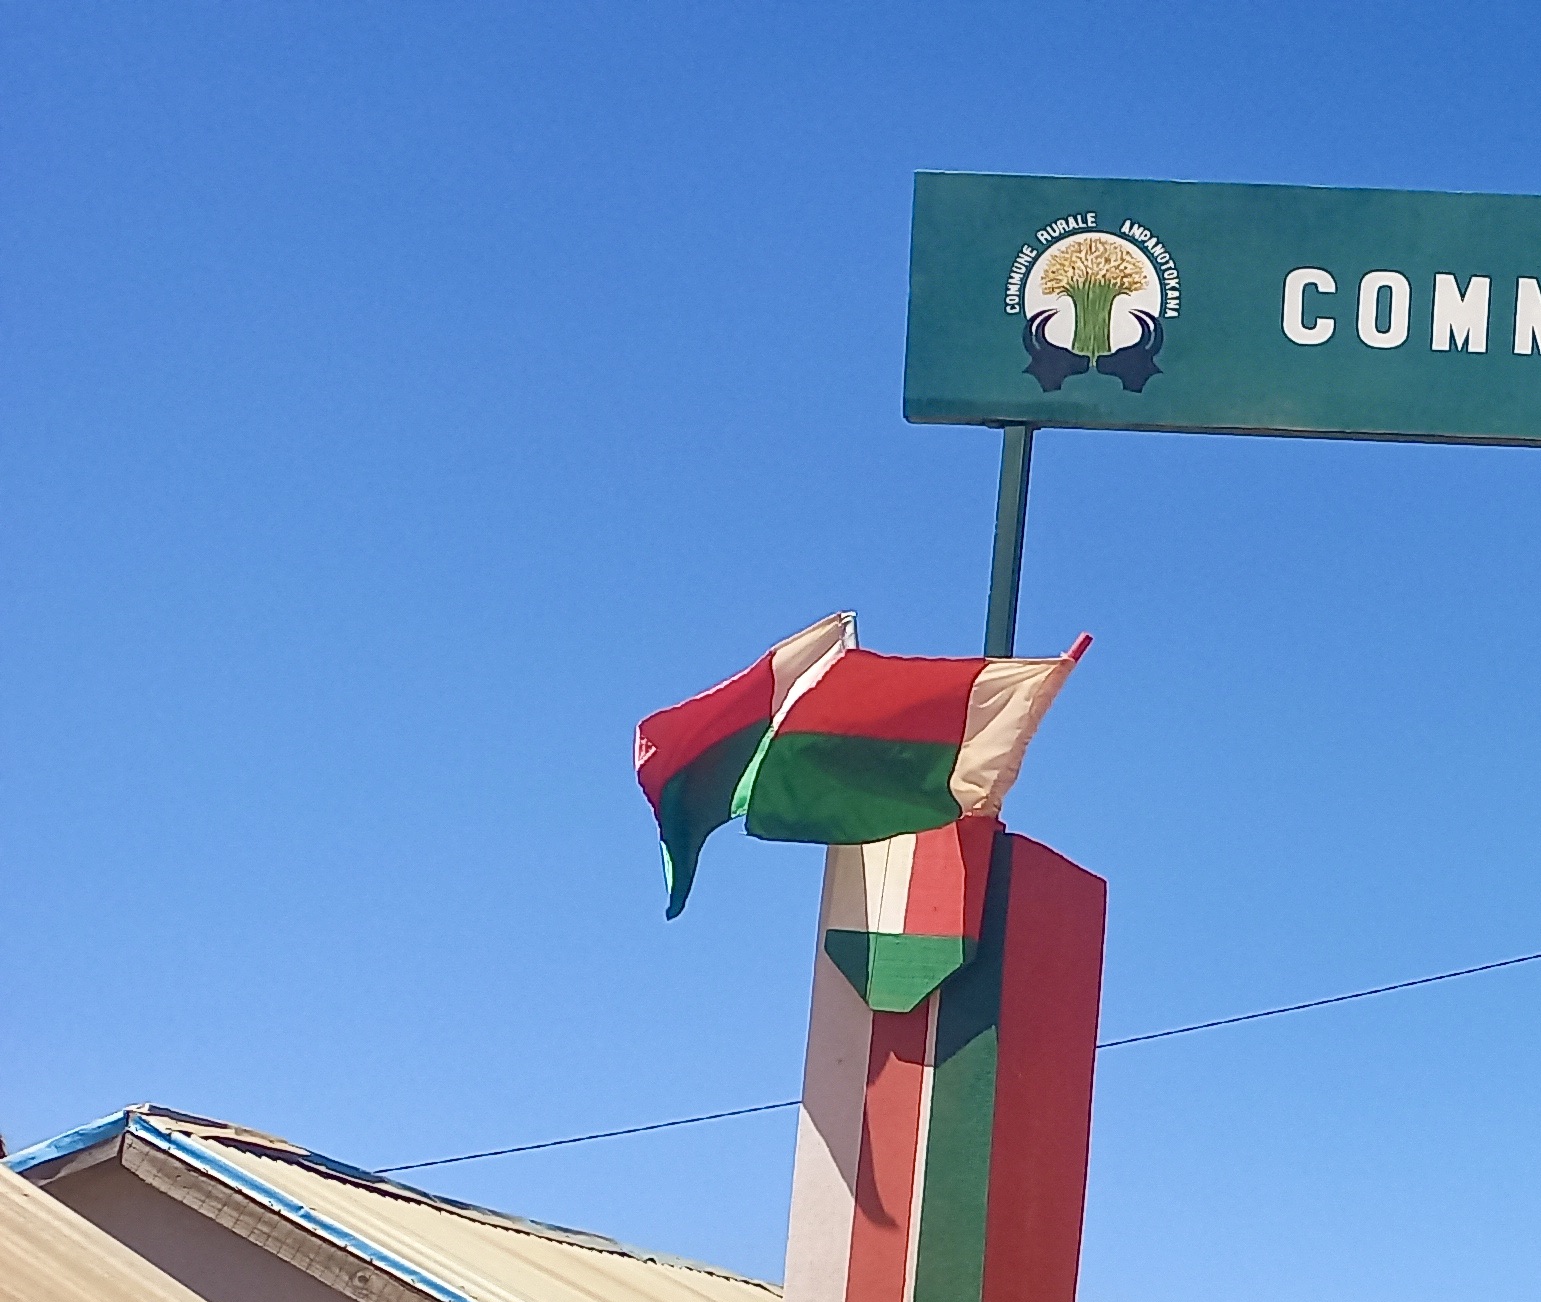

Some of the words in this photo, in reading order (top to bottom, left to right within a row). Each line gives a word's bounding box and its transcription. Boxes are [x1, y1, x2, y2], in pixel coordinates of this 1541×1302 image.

[1004, 243, 1038, 315] COMMUNE
[1035, 211, 1098, 246] RURALE
[1119, 218, 1181, 319] AMPANOTOKANA
